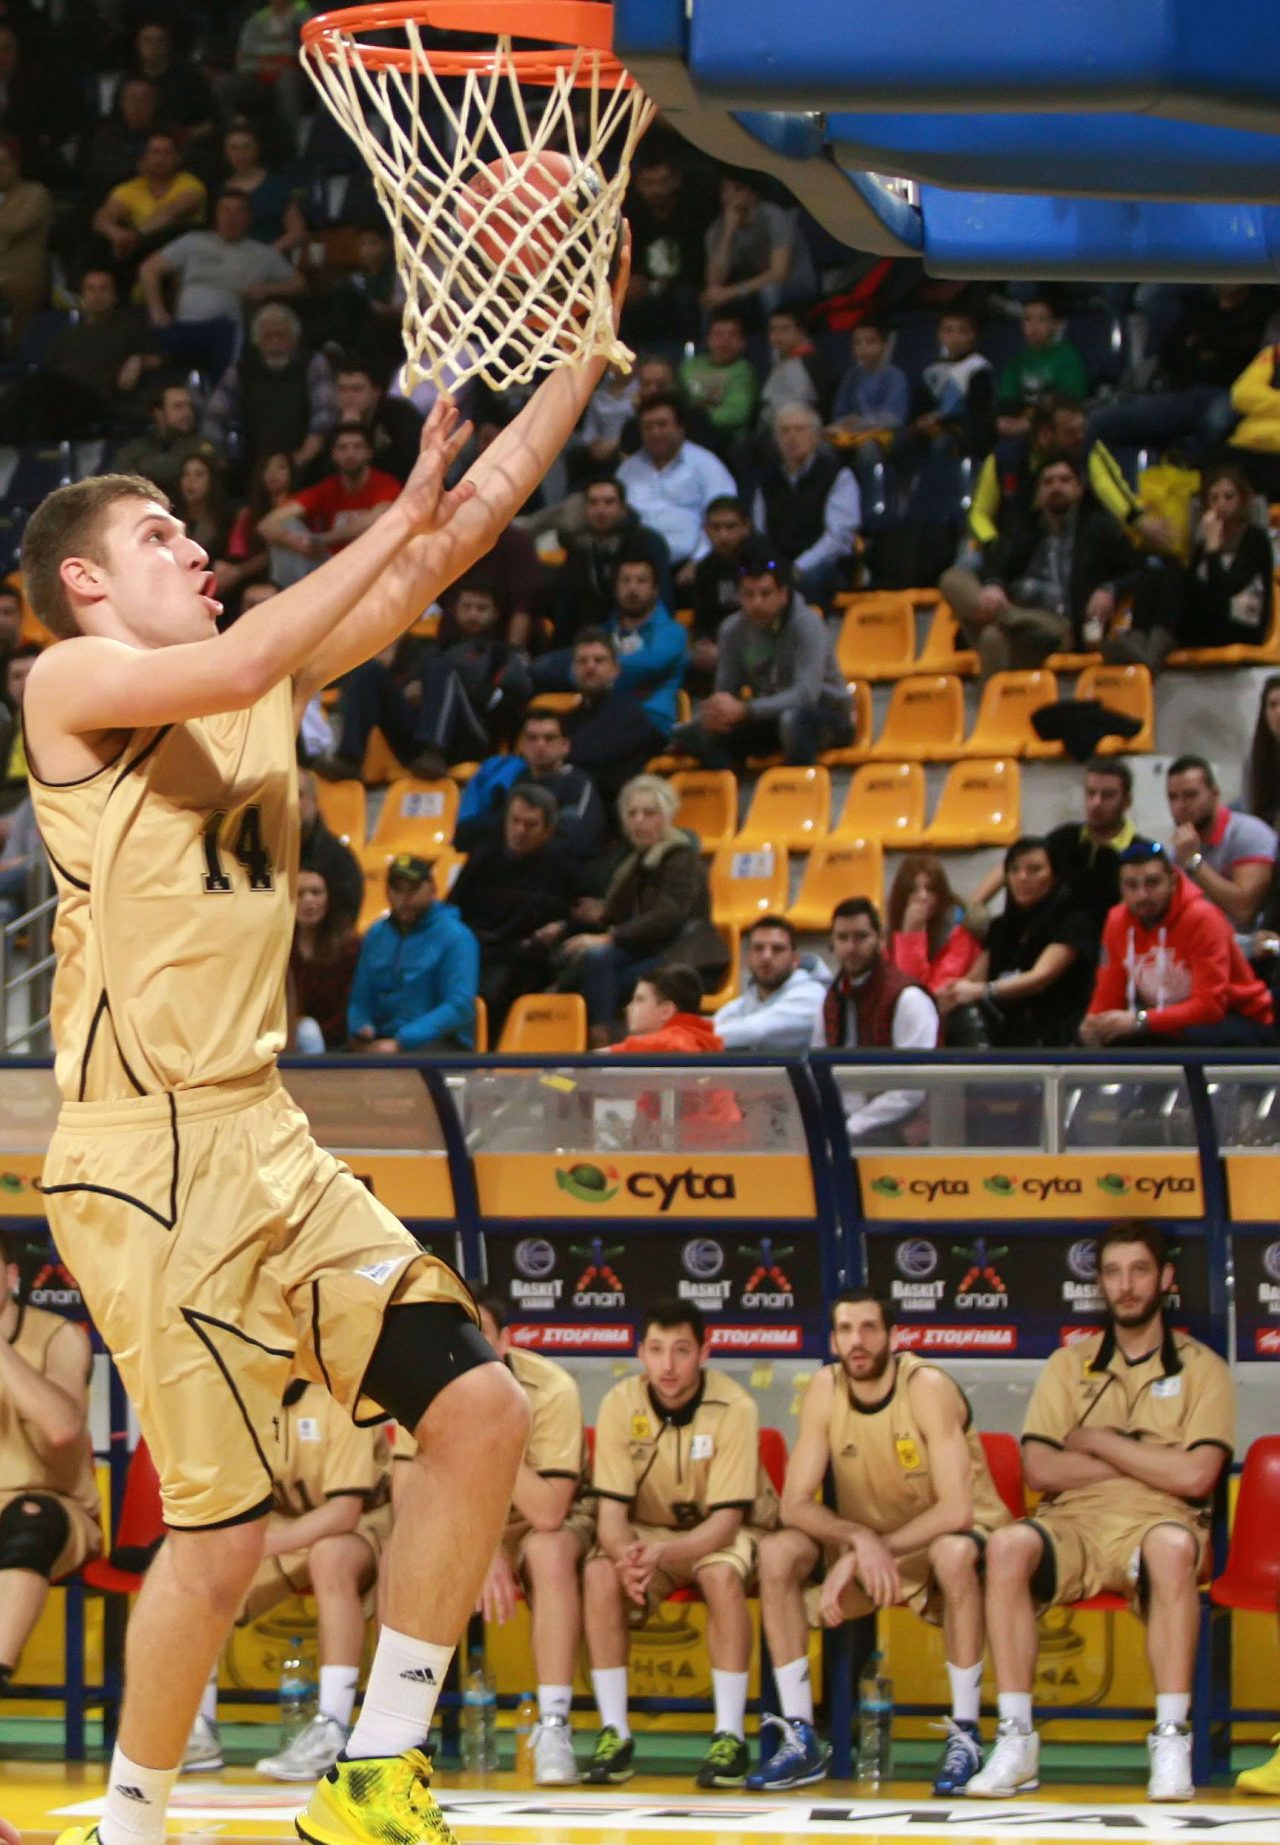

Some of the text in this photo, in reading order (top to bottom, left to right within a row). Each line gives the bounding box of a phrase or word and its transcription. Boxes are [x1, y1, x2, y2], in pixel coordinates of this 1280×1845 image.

[200, 804, 276, 894] 14
[626, 1167, 736, 1211] cyta
[909, 1176, 970, 1201] cyta
[1022, 1176, 1083, 1200] cyta
[1135, 1175, 1196, 1199] cyta
